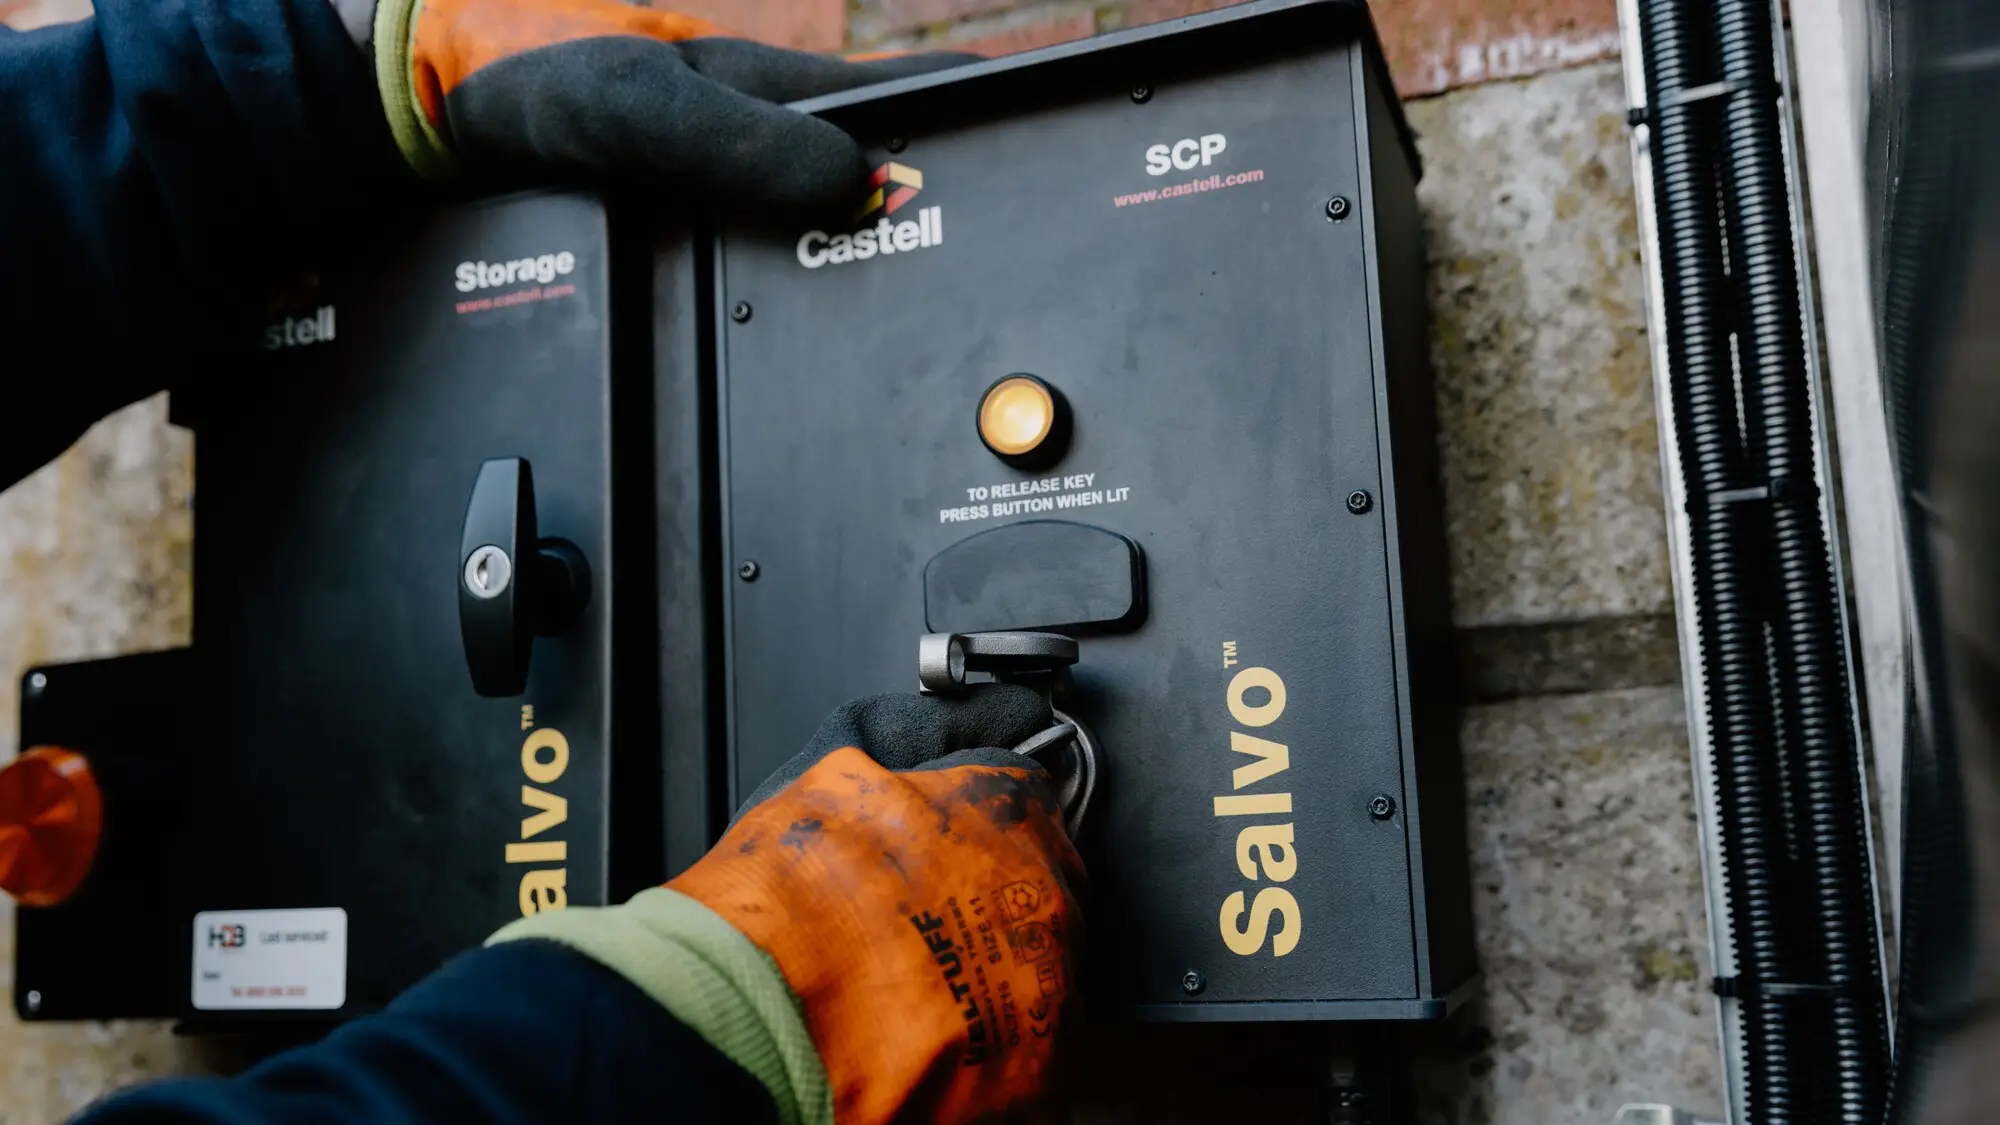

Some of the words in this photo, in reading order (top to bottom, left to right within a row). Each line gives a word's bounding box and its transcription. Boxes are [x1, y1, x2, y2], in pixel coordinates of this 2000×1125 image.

[1145, 133, 1227, 176] SCP
[1113, 169, 1265, 208] www.castell.com
[796, 205, 943, 269] Castell
[455, 251, 575, 292] Storage
[259, 304, 336, 351] stell
[940, 504, 989, 524] PRESS
[992, 497, 1053, 517] BUTTON
[1056, 490, 1102, 510] WHEN
[1106, 487, 1130, 503] LIT
[966, 487, 988, 502] TO
[991, 477, 1060, 500] RELEASE
[1063, 473, 1095, 489] KEY
[505, 704, 570, 919] alvo™
[976, 919, 1002, 964] SIZE
